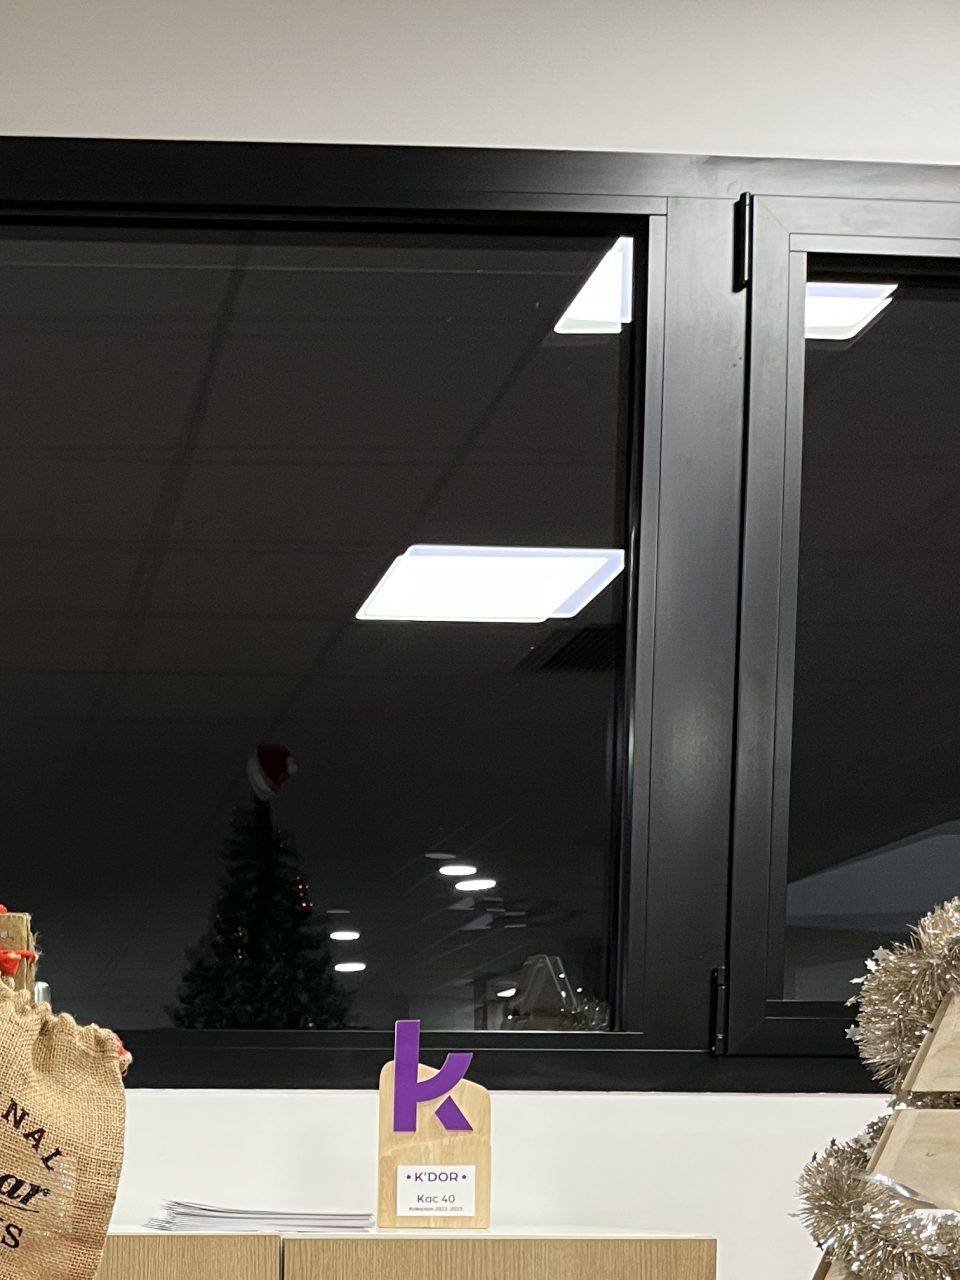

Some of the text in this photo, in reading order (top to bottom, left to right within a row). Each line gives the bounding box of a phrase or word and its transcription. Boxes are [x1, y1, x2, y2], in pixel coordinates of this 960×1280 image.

[414, 1171, 459, 1182] K'DOR
[417, 1194, 456, 1203] Kac 40
